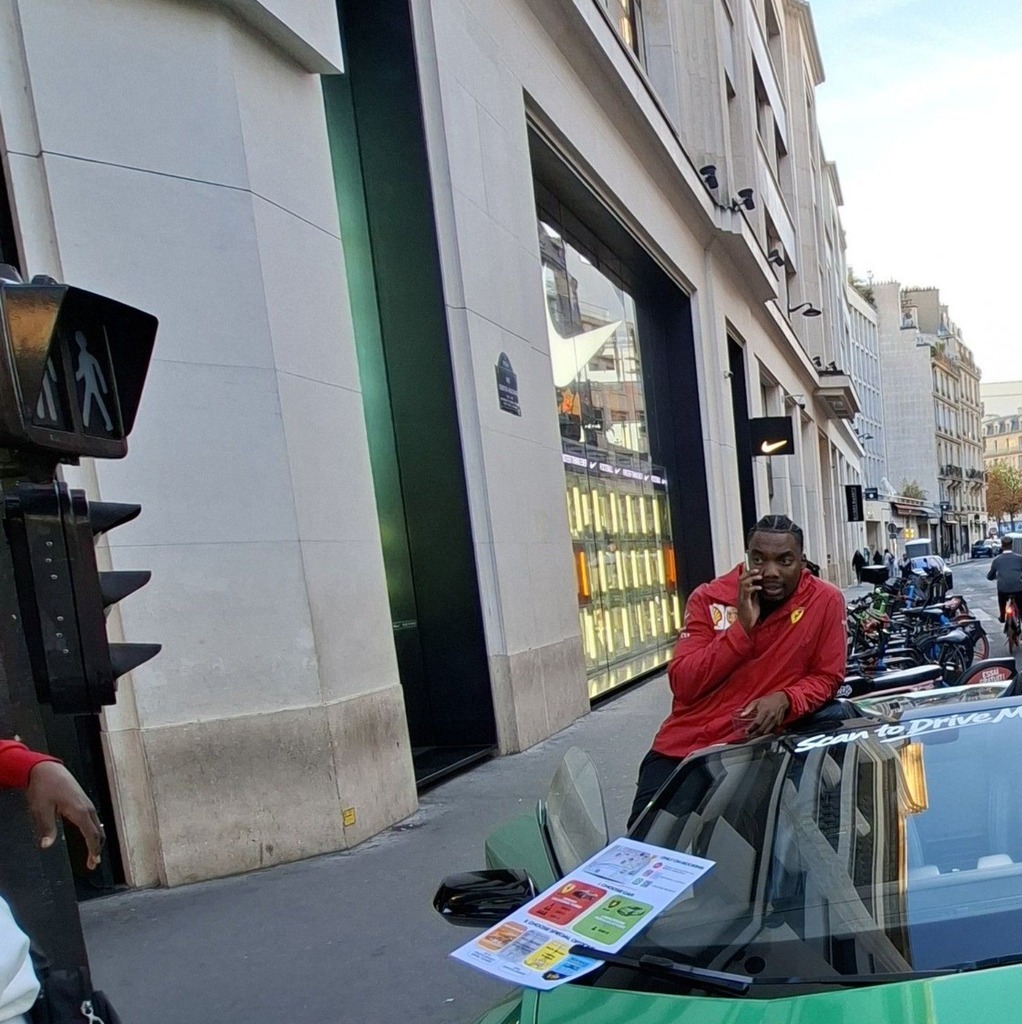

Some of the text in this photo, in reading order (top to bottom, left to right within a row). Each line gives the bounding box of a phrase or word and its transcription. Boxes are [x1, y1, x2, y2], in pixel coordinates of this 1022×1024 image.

[794, 730, 869, 753] Scan
[877, 723, 901, 738] to
[908, 712, 993, 735] Drive
